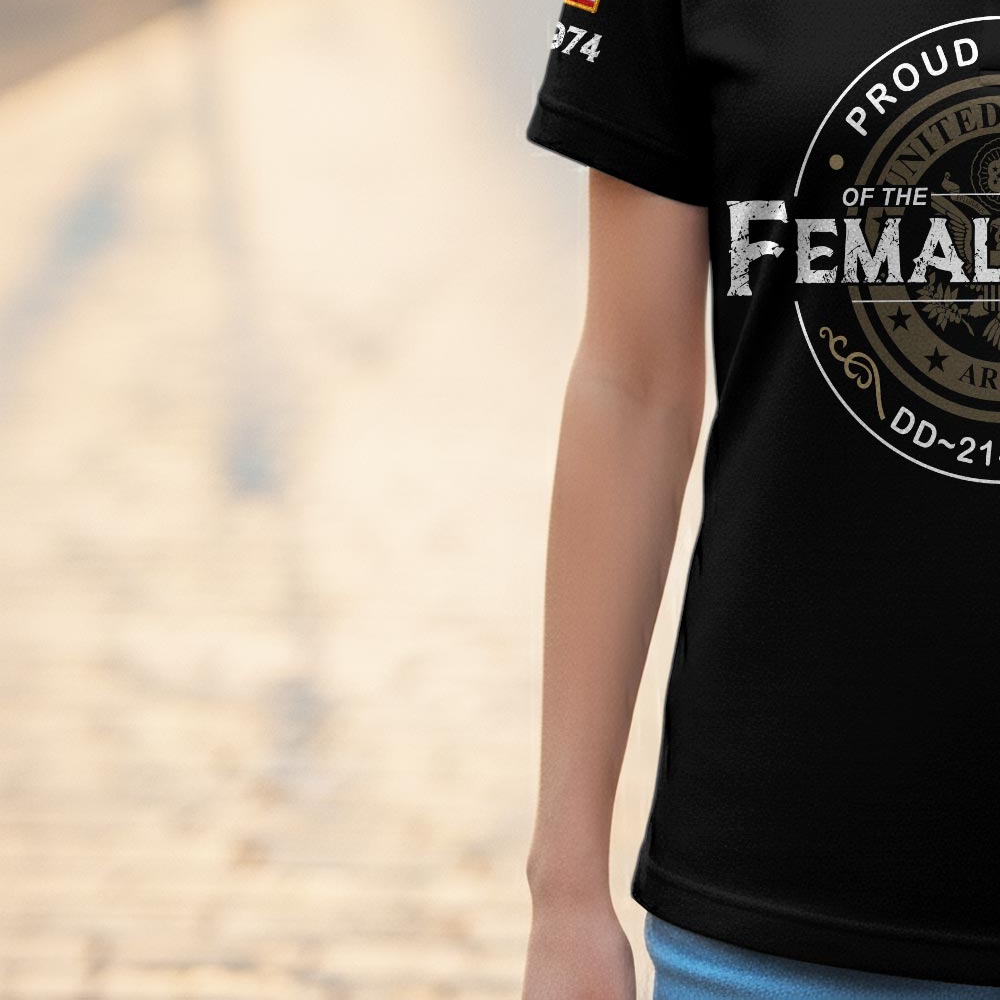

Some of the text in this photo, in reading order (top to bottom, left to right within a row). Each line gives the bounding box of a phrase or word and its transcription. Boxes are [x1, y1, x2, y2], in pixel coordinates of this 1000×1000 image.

[846, 37, 979, 137] PROUD
[842, 187, 929, 207] OF THE
